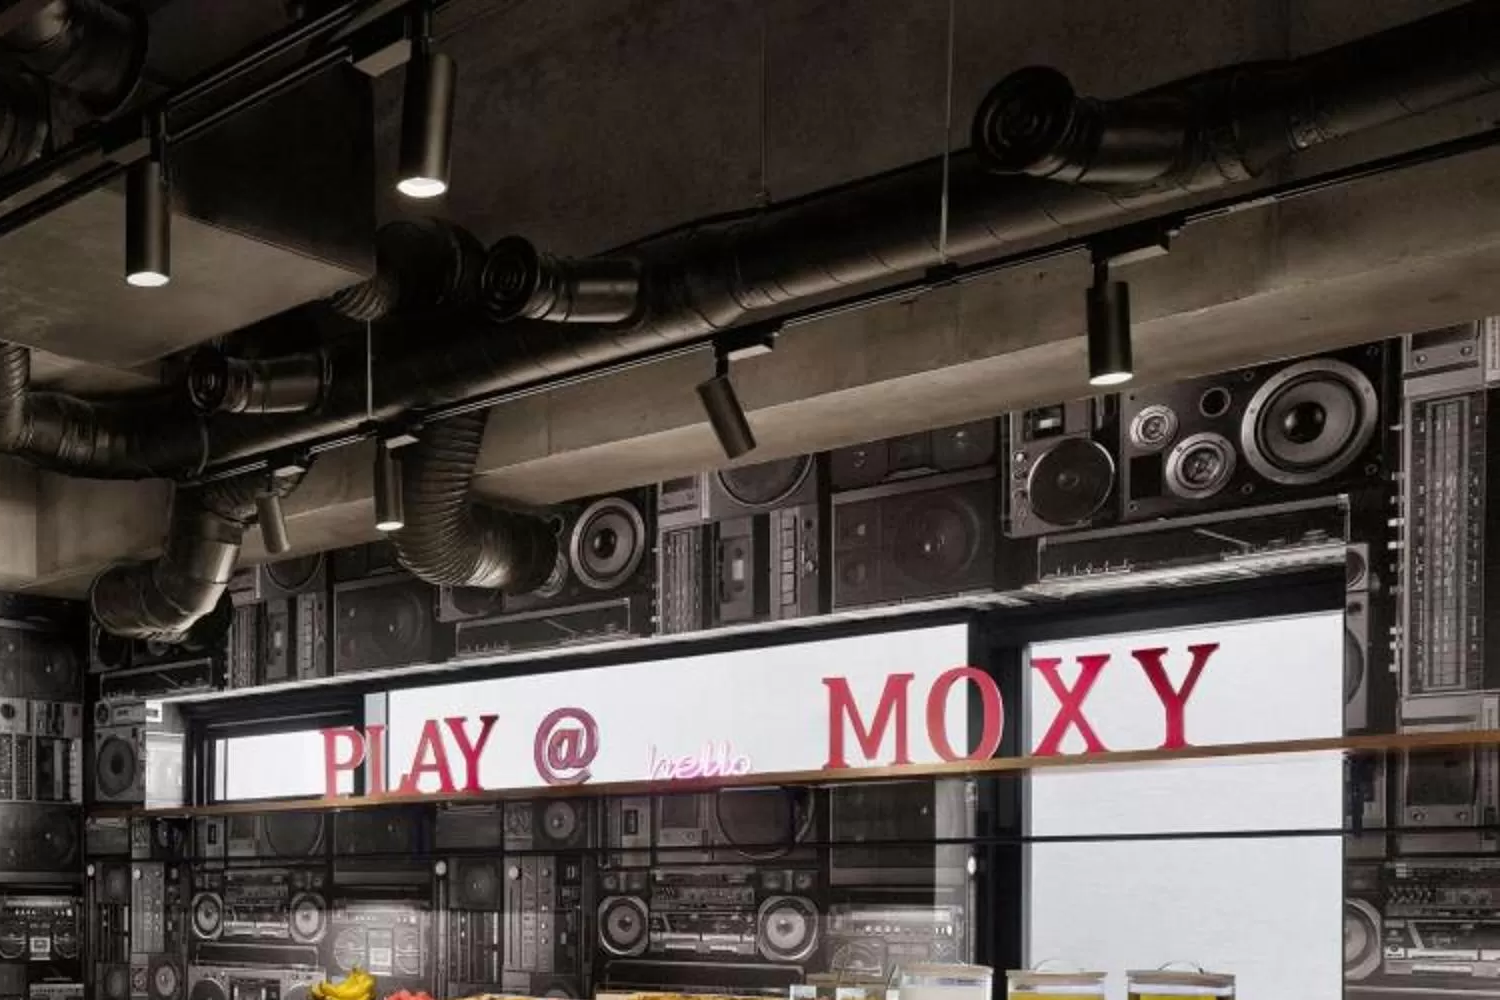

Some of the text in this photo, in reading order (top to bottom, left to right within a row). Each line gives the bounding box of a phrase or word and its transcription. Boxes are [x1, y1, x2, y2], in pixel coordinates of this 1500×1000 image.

[320, 642, 1220, 801] PLAY @ MOXY
[646, 740, 752, 781] hello
